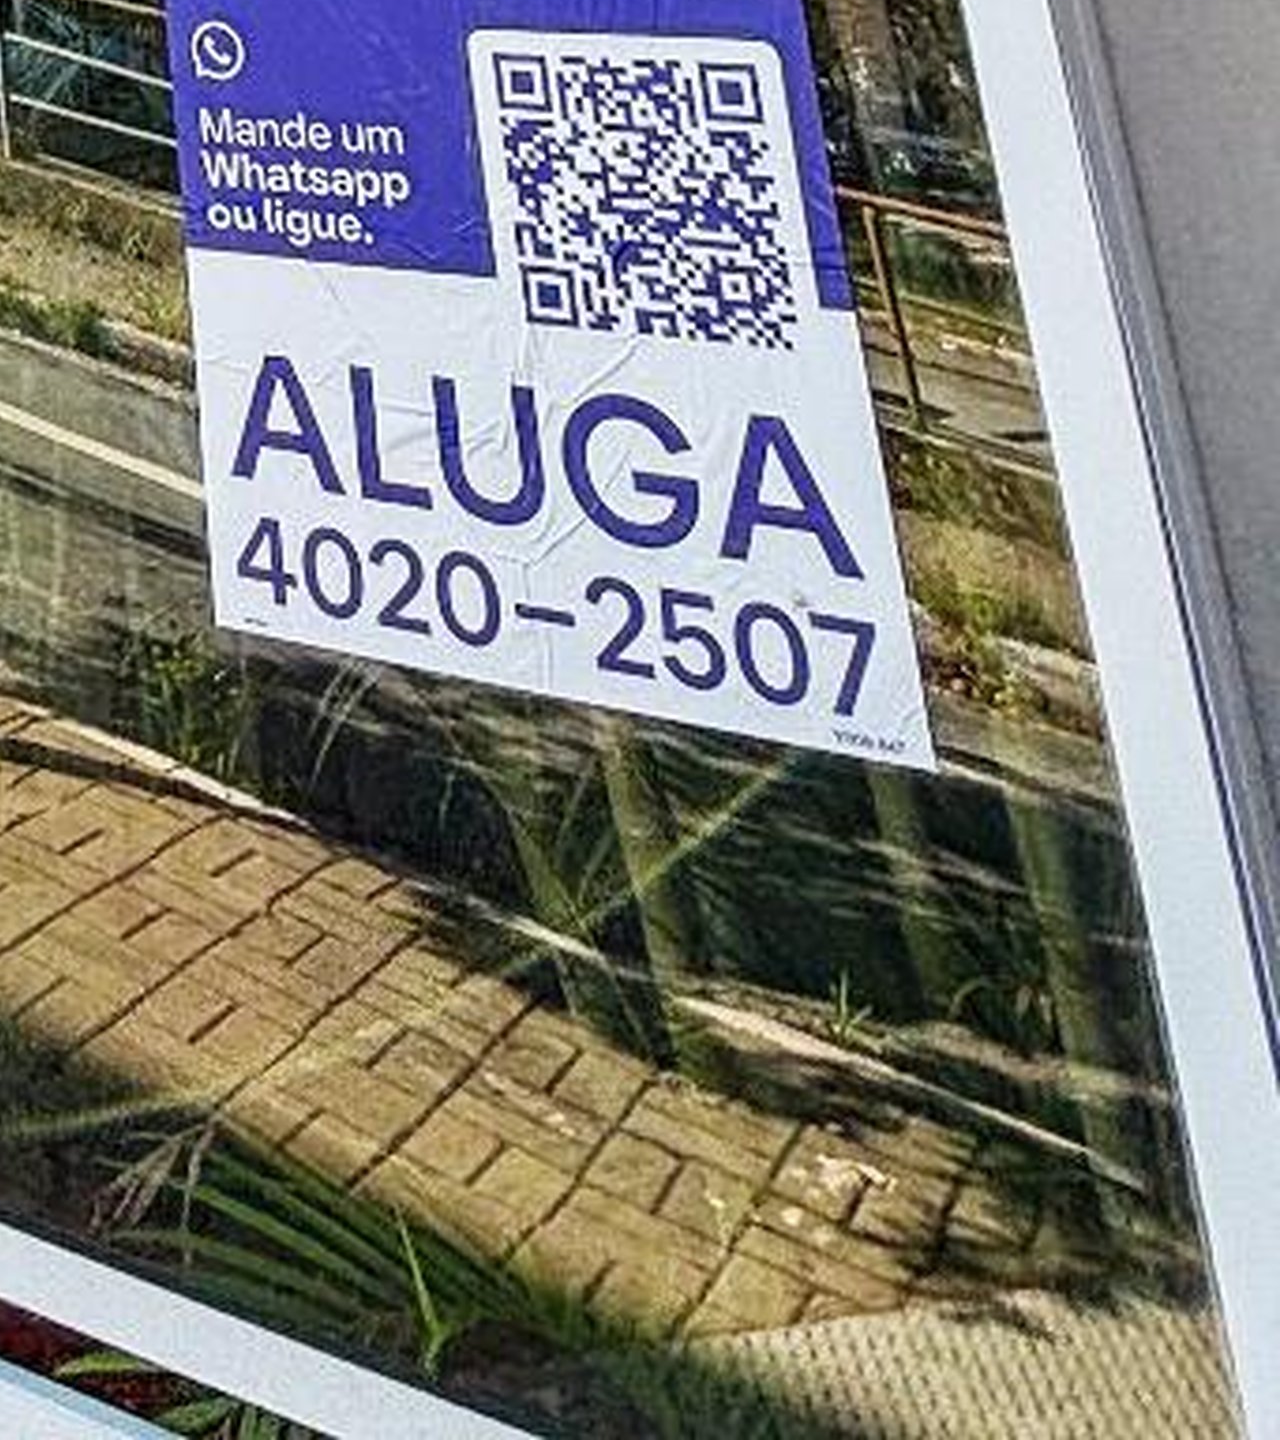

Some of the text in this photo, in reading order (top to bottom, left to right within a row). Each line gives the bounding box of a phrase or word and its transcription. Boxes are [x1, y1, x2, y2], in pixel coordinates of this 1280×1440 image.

[198, 107, 405, 155] Mande um
[200, 150, 410, 209] Whatsapp
[207, 198, 374, 247] ou ligue.
[230, 354, 865, 580] ALUGA
[238, 517, 876, 717] 4020-2507
